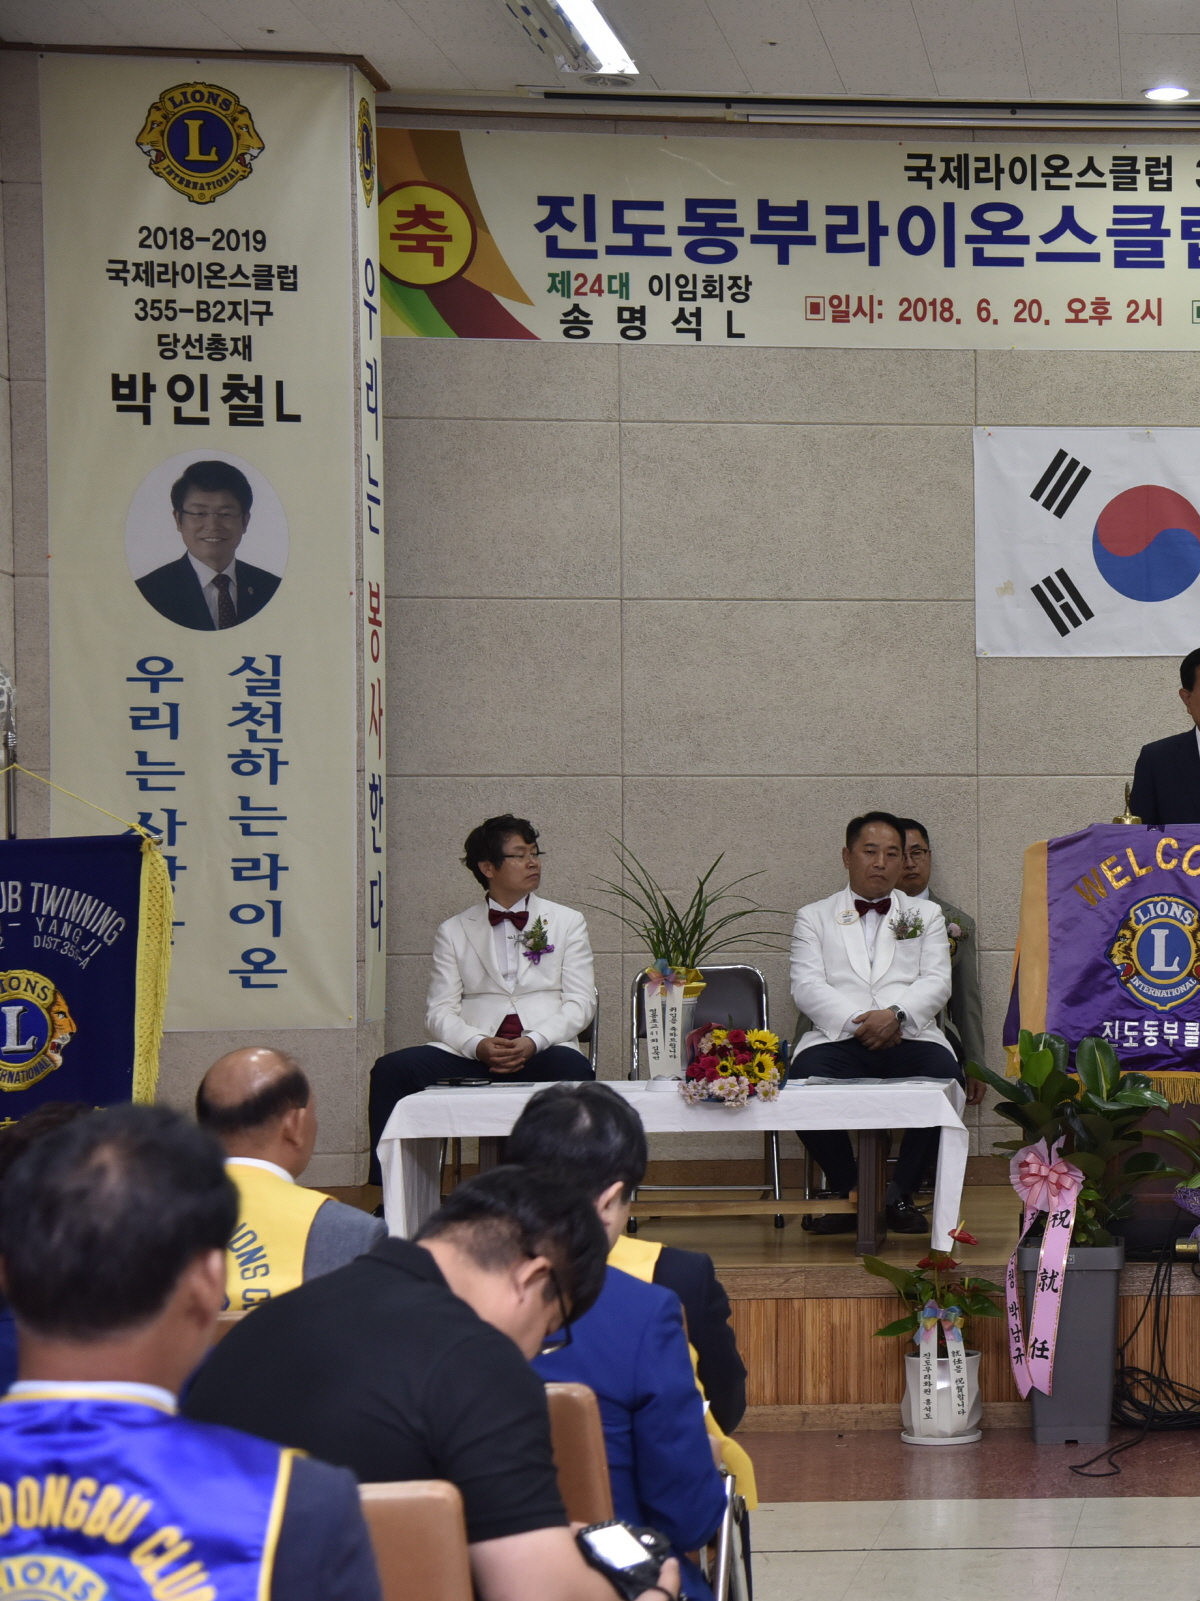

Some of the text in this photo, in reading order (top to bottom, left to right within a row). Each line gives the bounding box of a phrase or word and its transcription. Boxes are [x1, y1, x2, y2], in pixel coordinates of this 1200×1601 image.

[168, 89, 232, 111] LIONS
[184, 120, 218, 161] L
[163, 164, 239, 190] INTERNATIONAL
[903, 152, 1174, 192] 국제라이온스클럽
[138, 226, 267, 252] 2018-2019
[389, 204, 453, 268] 축
[105, 259, 299, 291] 국제라이온스클럽
[546, 270, 753, 304] 제24대 이임회장
[134, 298, 274, 326] 355-B2지구
[1064, 296, 1113, 327] 오후
[1126, 297, 1164, 327] 2시
[157, 333, 253, 361] 당선총재
[125, 655, 186, 791] 우리는
[30, 882, 126, 946] TWINNING
[1135, 902, 1195, 925] LIONS
[1150, 929, 1180, 972] L
[1130, 975, 1197, 998] INTERNATIONAL
[1, 1006, 38, 1055] L
[130, 1525, 217, 1600] CLU
[0, 1562, 96, 1600] IONS
